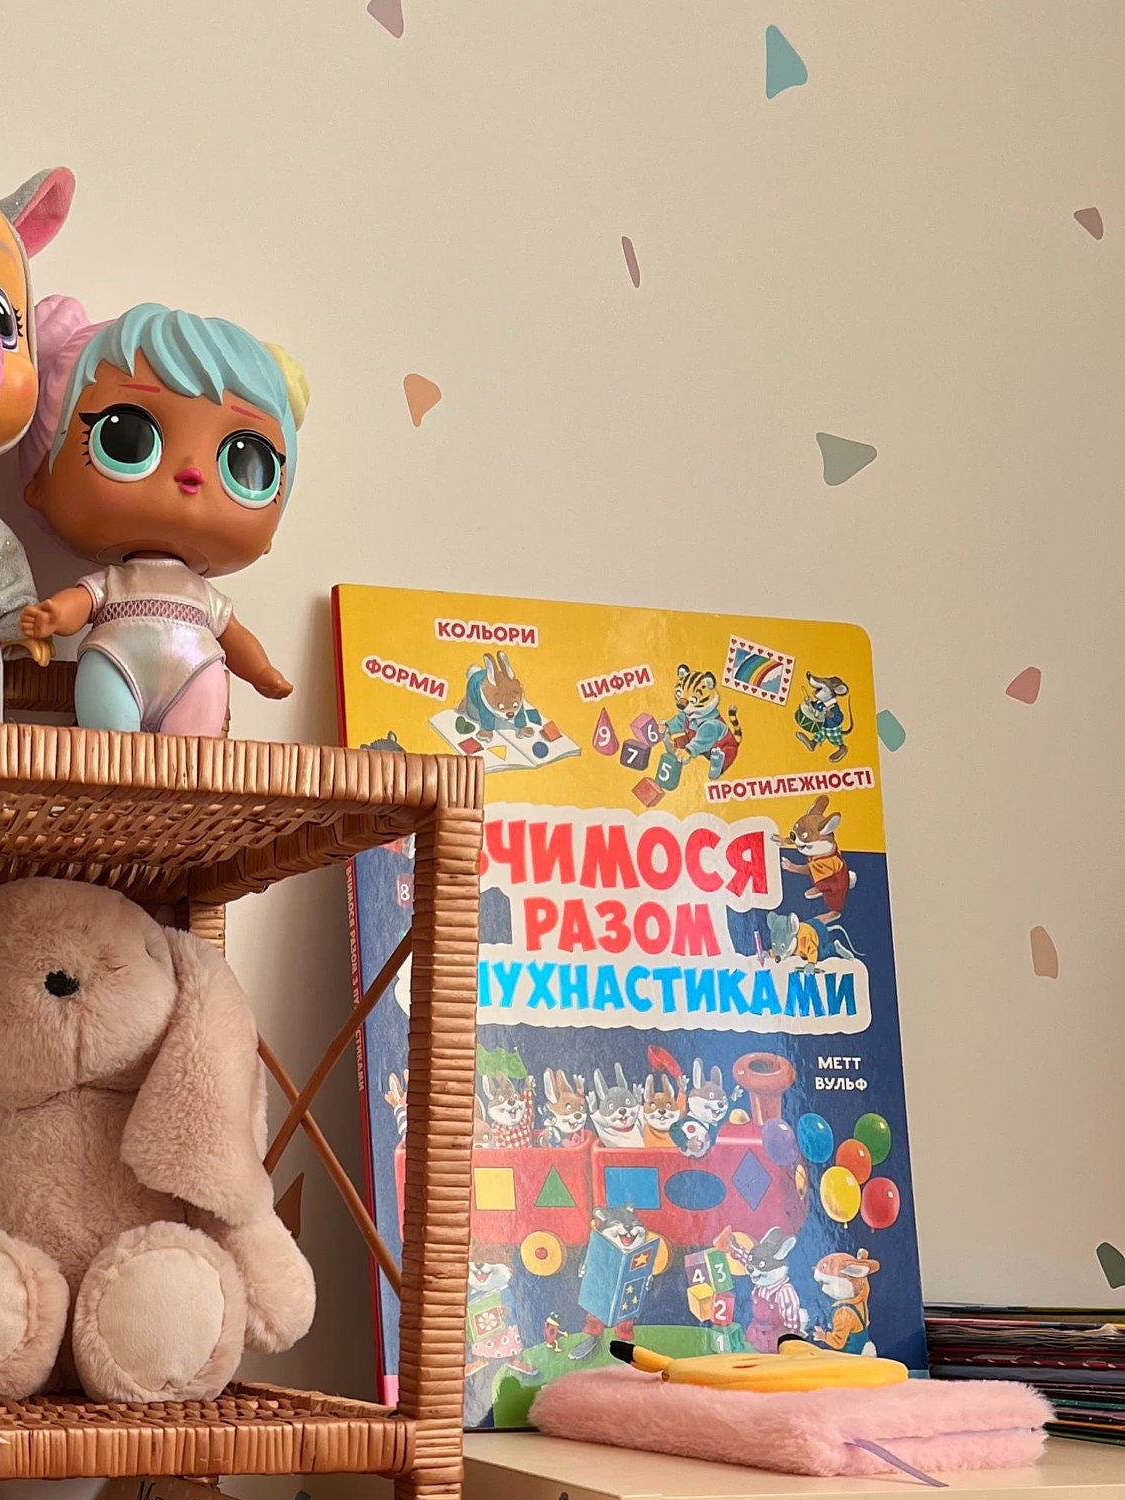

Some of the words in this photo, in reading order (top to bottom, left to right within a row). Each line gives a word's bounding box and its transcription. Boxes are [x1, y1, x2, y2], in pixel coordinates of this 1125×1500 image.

[438, 622, 536, 644] КОЛЬОРИ
[365, 659, 446, 697] ФОРМИ
[580, 668, 651, 698] ЦИФРИ
[598, 726, 611, 747] 9
[647, 724, 659, 742] 6
[626, 748, 638, 764] 7
[658, 762, 672, 781] 5
[707, 770, 872, 800] ПРОТИЛЕЖНОСТІ
[480, 819, 768, 898] ЧИМОСЯ
[400, 884, 410, 900] 8
[524, 897, 721, 957] РАЗОМ
[818, 1056, 861, 1070] МЕТТ
[815, 1077, 868, 1091] ВУЛЬФ
[692, 1268, 705, 1283] 4
[715, 1263, 726, 1282] 3
[714, 1299, 726, 1320] 2
